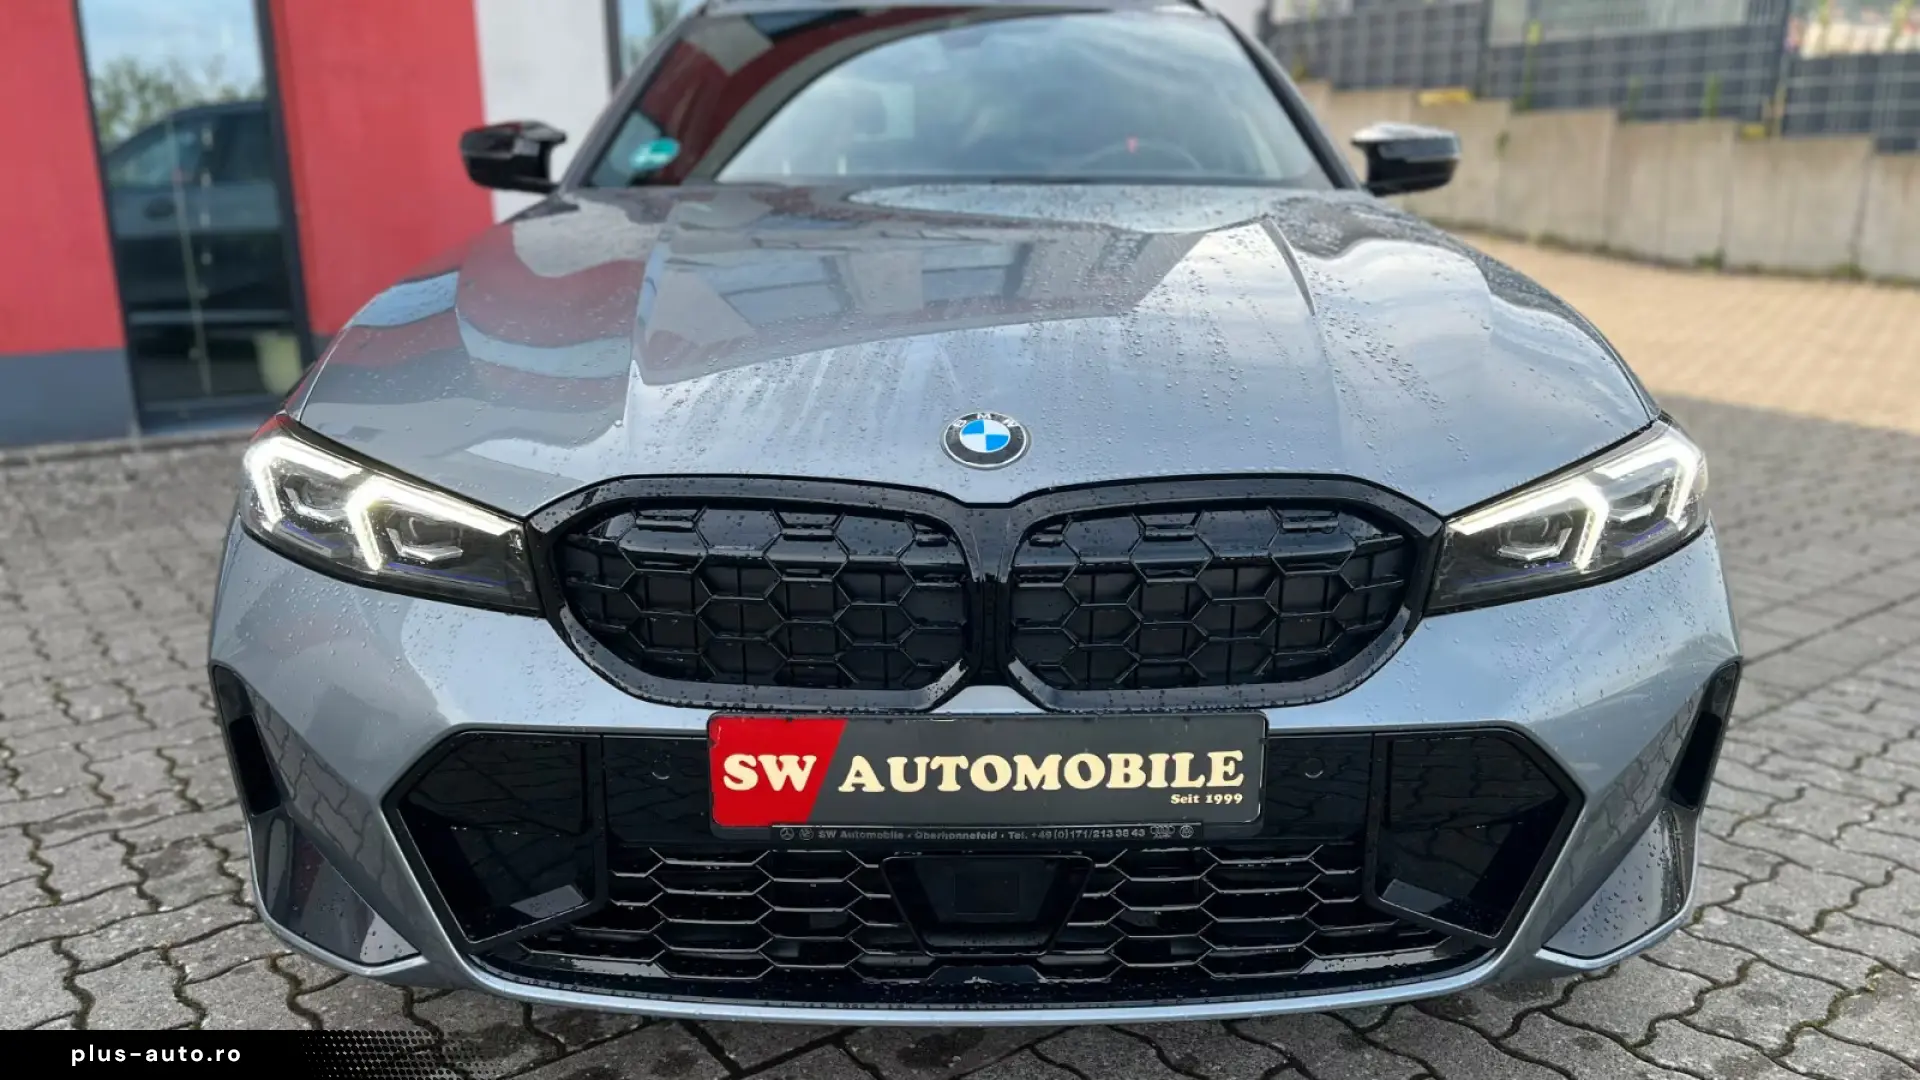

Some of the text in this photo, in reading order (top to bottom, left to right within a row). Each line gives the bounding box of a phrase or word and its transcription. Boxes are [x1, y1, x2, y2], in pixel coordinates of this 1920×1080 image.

[722, 750, 1245, 793] SW AUTOMOBILE
[1170, 793, 1244, 805] Seit 1999
[817, 829, 838, 839] SW
[839, 829, 905, 840] Automobile
